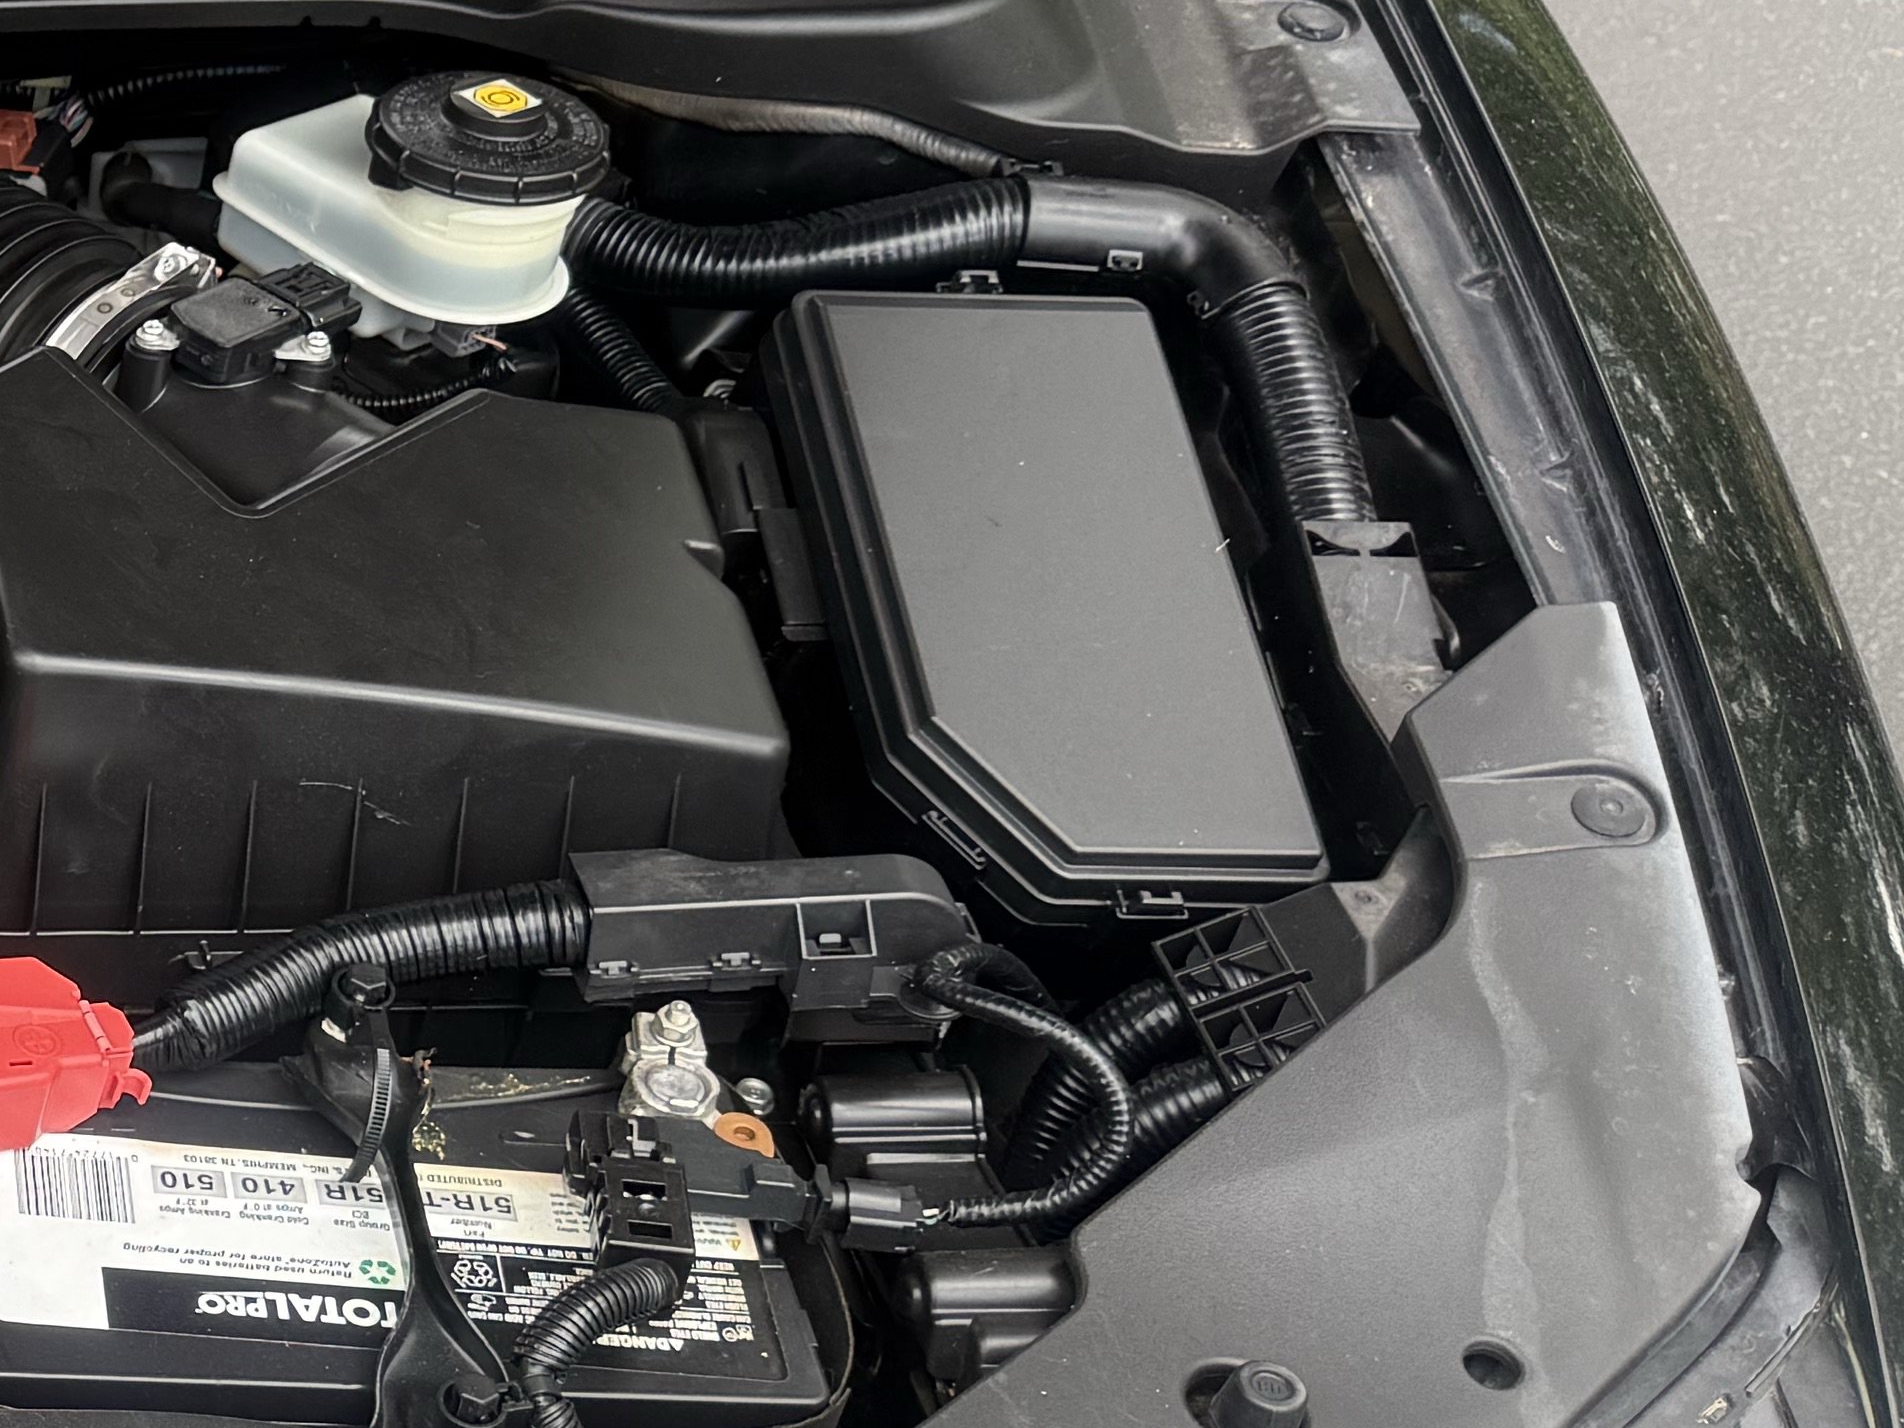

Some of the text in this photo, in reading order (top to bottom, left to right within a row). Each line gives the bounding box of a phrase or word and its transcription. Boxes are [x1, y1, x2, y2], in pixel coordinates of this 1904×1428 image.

[160, 1171, 213, 1191] 510
[241, 1176, 295, 1196] 410
[324, 1183, 383, 1203] 51R
[239, 1211, 284, 1224] Cranking
[451, 1218, 491, 1229] Number
[123, 1243, 179, 1254] recycling
[184, 1248, 225, 1258] proper
[229, 1252, 245, 1261] for
[251, 1254, 282, 1262] store
[198, 1259, 209, 1267] to
[216, 1260, 269, 1273] batteries
[275, 1265, 304, 1274] used
[309, 1269, 351, 1278] Return
[197, 1291, 398, 1327] TOTALPRO
